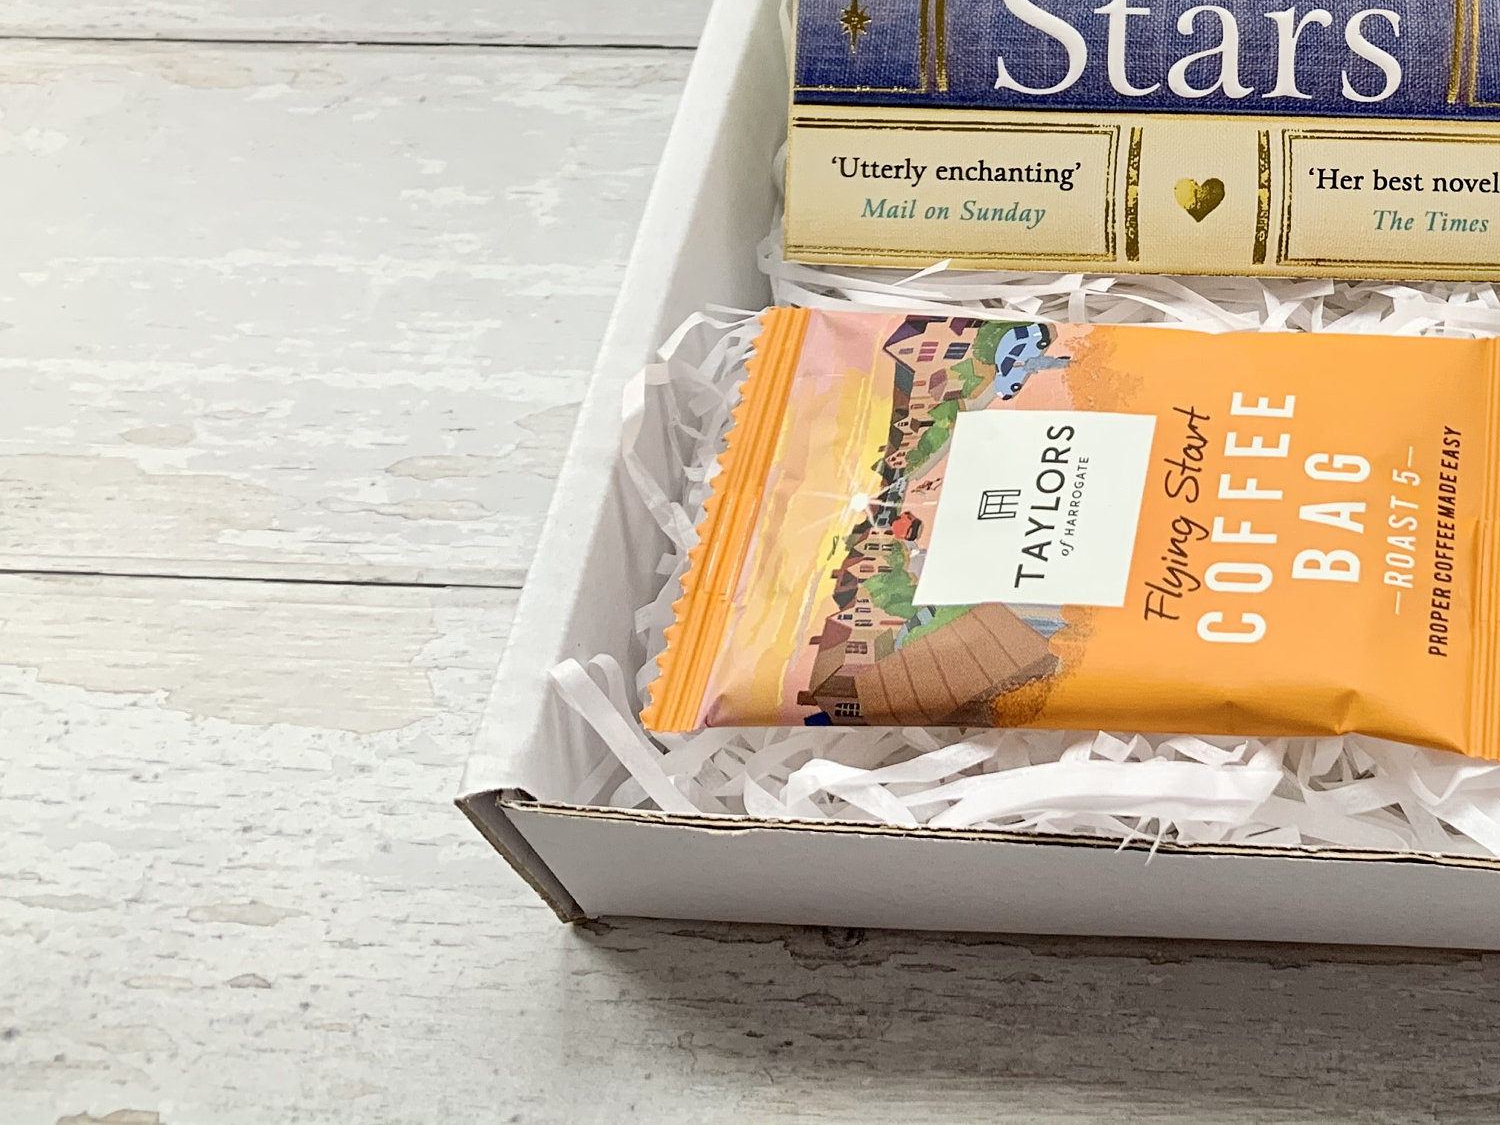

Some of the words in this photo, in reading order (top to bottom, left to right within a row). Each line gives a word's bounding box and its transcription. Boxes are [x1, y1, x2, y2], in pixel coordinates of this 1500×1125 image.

[860, 198, 916, 220] Mail
[924, 206, 950, 220] on
[960, 200, 1046, 230] Sunday
[1373, 169, 1424, 191] best
[1432, 172, 1500, 194] novel
[1373, 210, 1415, 231] The
[1424, 211, 1489, 233] Times
[1163, 405, 1211, 503] Start
[1441, 425, 1462, 470] EASY
[1014, 425, 1075, 588] TAYLORS
[1064, 456, 1090, 536] HARROGATE
[1196, 391, 1297, 644] COFFEE
[1291, 452, 1371, 583] BAG
[1438, 471, 1458, 520] MADE
[1061, 539, 1075, 557] of
[1144, 515, 1210, 621] Flying
[1383, 495, 1420, 588] ROAST
[1434, 520, 1456, 584] COFFEE
[1428, 587, 1451, 658] PROPER
